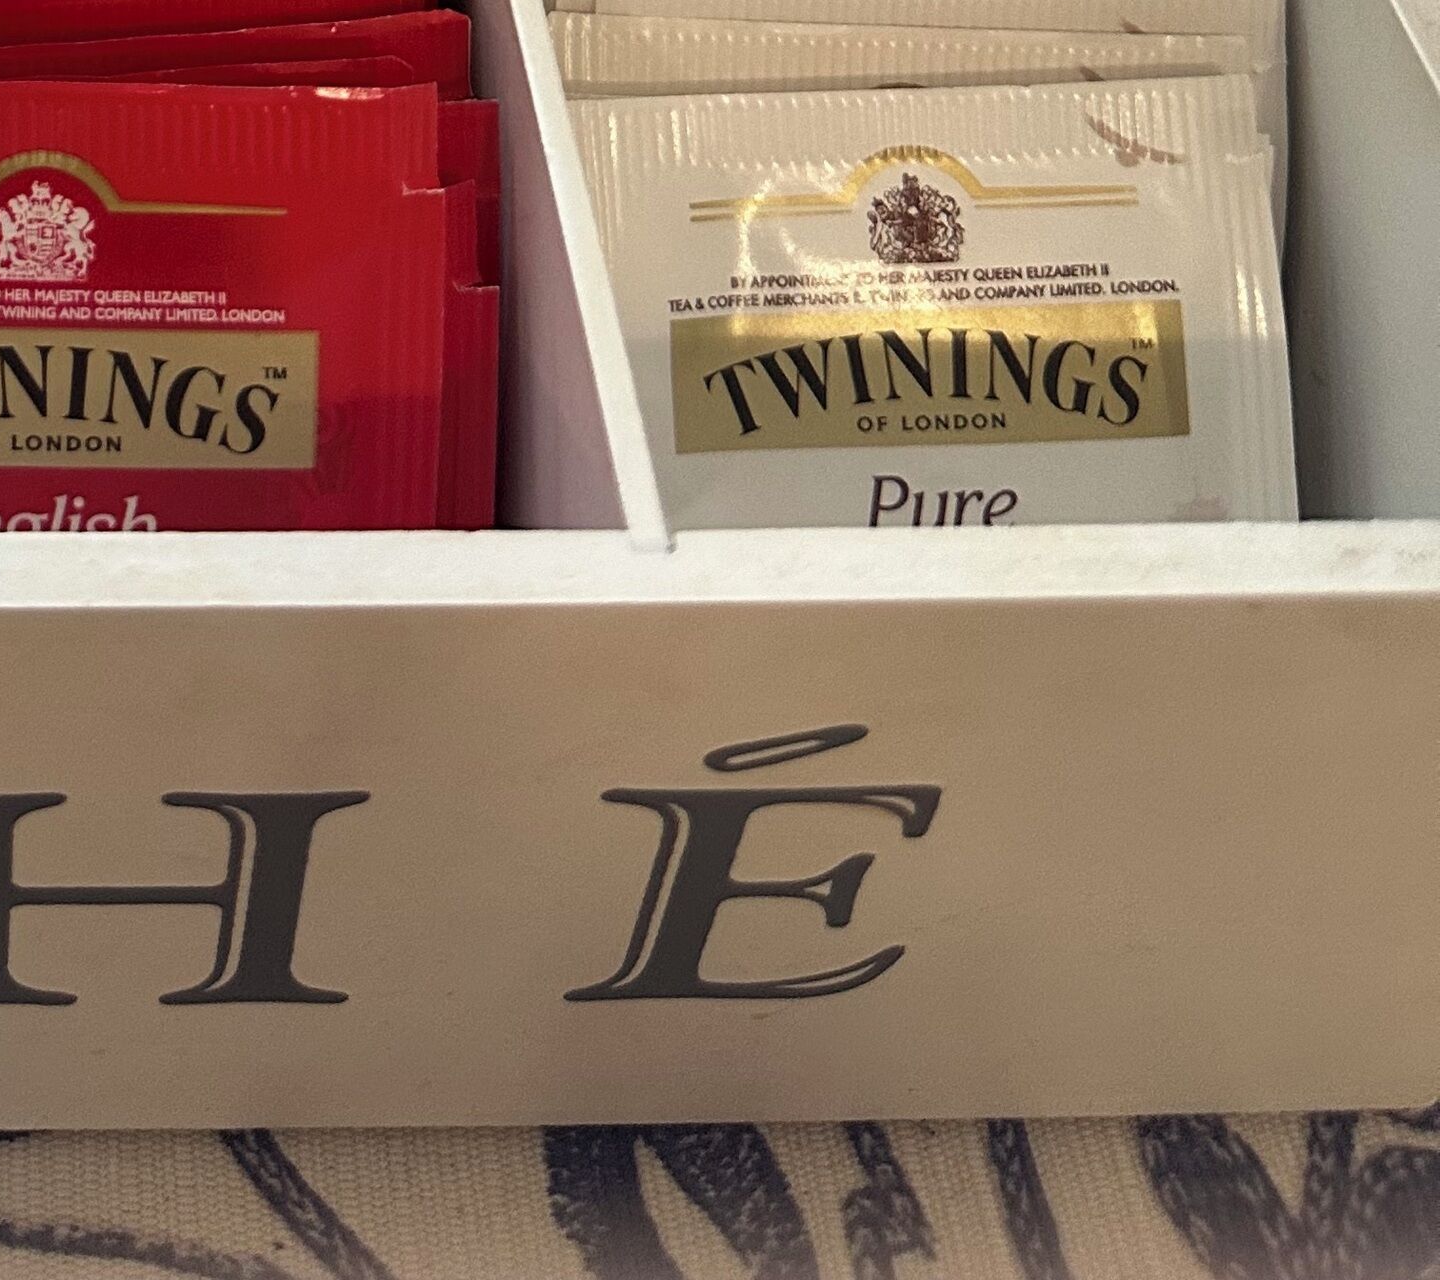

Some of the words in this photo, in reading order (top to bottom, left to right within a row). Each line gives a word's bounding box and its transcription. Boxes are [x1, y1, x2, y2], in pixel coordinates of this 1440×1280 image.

[750, 272, 848, 288] APPOINT
[879, 271, 905, 284] HER
[973, 266, 1022, 280] QUEEN
[1026, 264, 1097, 279] ELIZABETH
[5, 289, 31, 301] HER
[34, 289, 90, 304] MAJESTY
[94, 290, 141, 304] QUEEN
[144, 291, 215, 303] ELIZABETH
[668, 298, 692, 312] TEA
[695, 297, 704, 310] &
[707, 294, 759, 308] COFFEE
[763, 292, 848, 306] MERCHANTS
[939, 288, 970, 301] AND
[974, 284, 1045, 299] COMPANY
[60, 307, 90, 319] AND
[94, 307, 161, 320] COMPANY
[222, 309, 286, 322] LONDON
[703, 327, 1148, 437] TWININGS
[857, 415, 888, 432] OF
[901, 414, 1007, 431] LONDON
[11, 435, 123, 452] LONDON
[869, 474, 1018, 527] Pure
